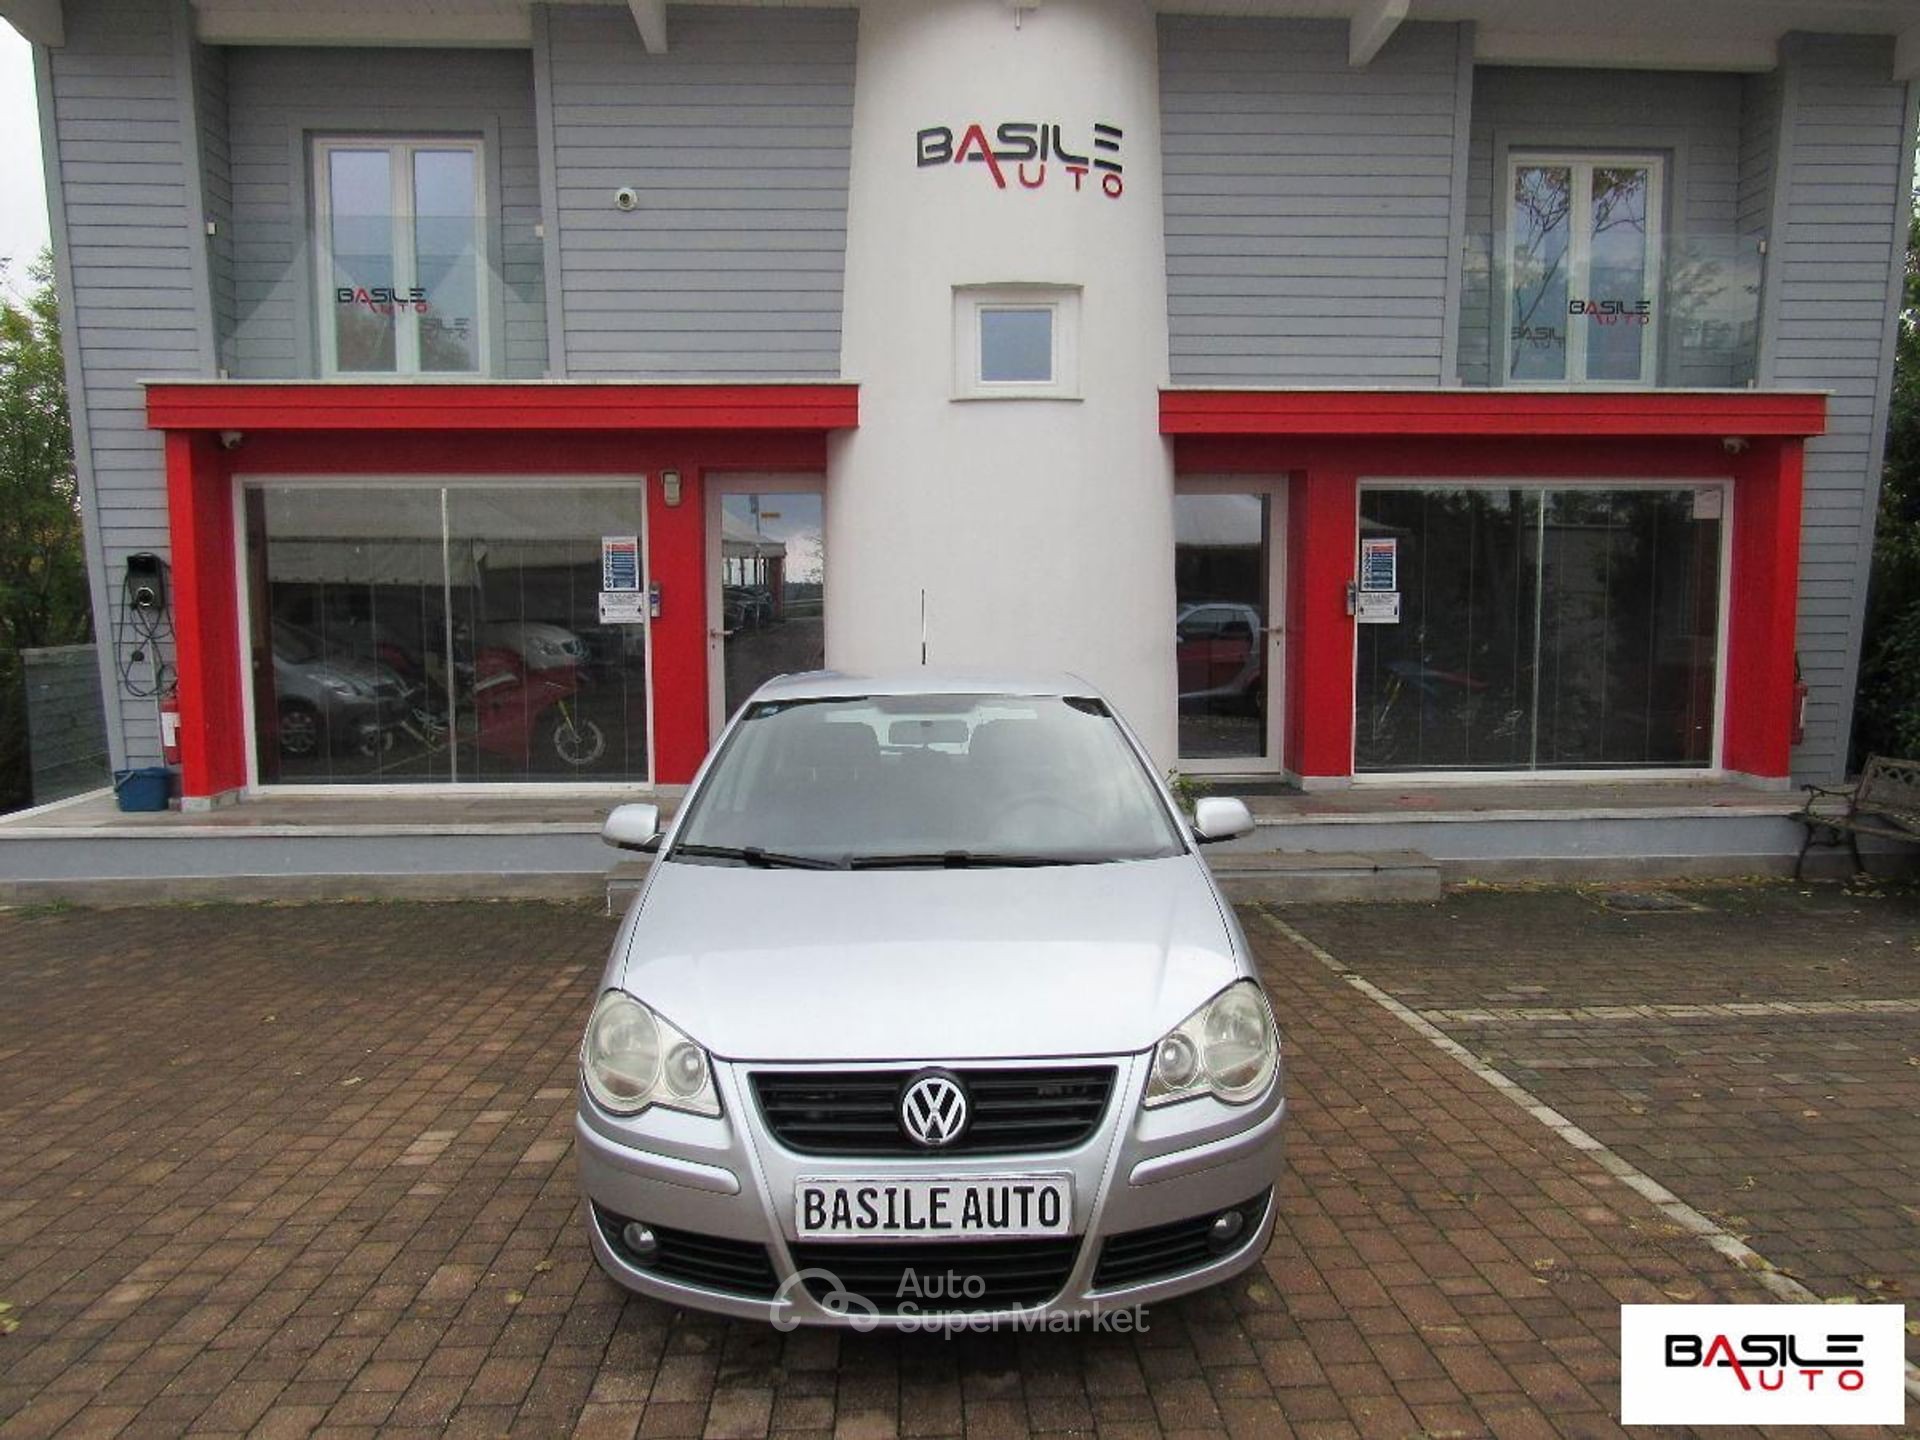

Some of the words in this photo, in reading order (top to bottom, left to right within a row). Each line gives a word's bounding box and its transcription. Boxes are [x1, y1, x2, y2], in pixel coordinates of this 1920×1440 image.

[916, 123, 1124, 174] BASILE
[337, 287, 427, 303] BASILE
[1569, 300, 1651, 315] BASILE
[803, 1186, 952, 1231] BASILE
[960, 1185, 1062, 1229] AUTO
